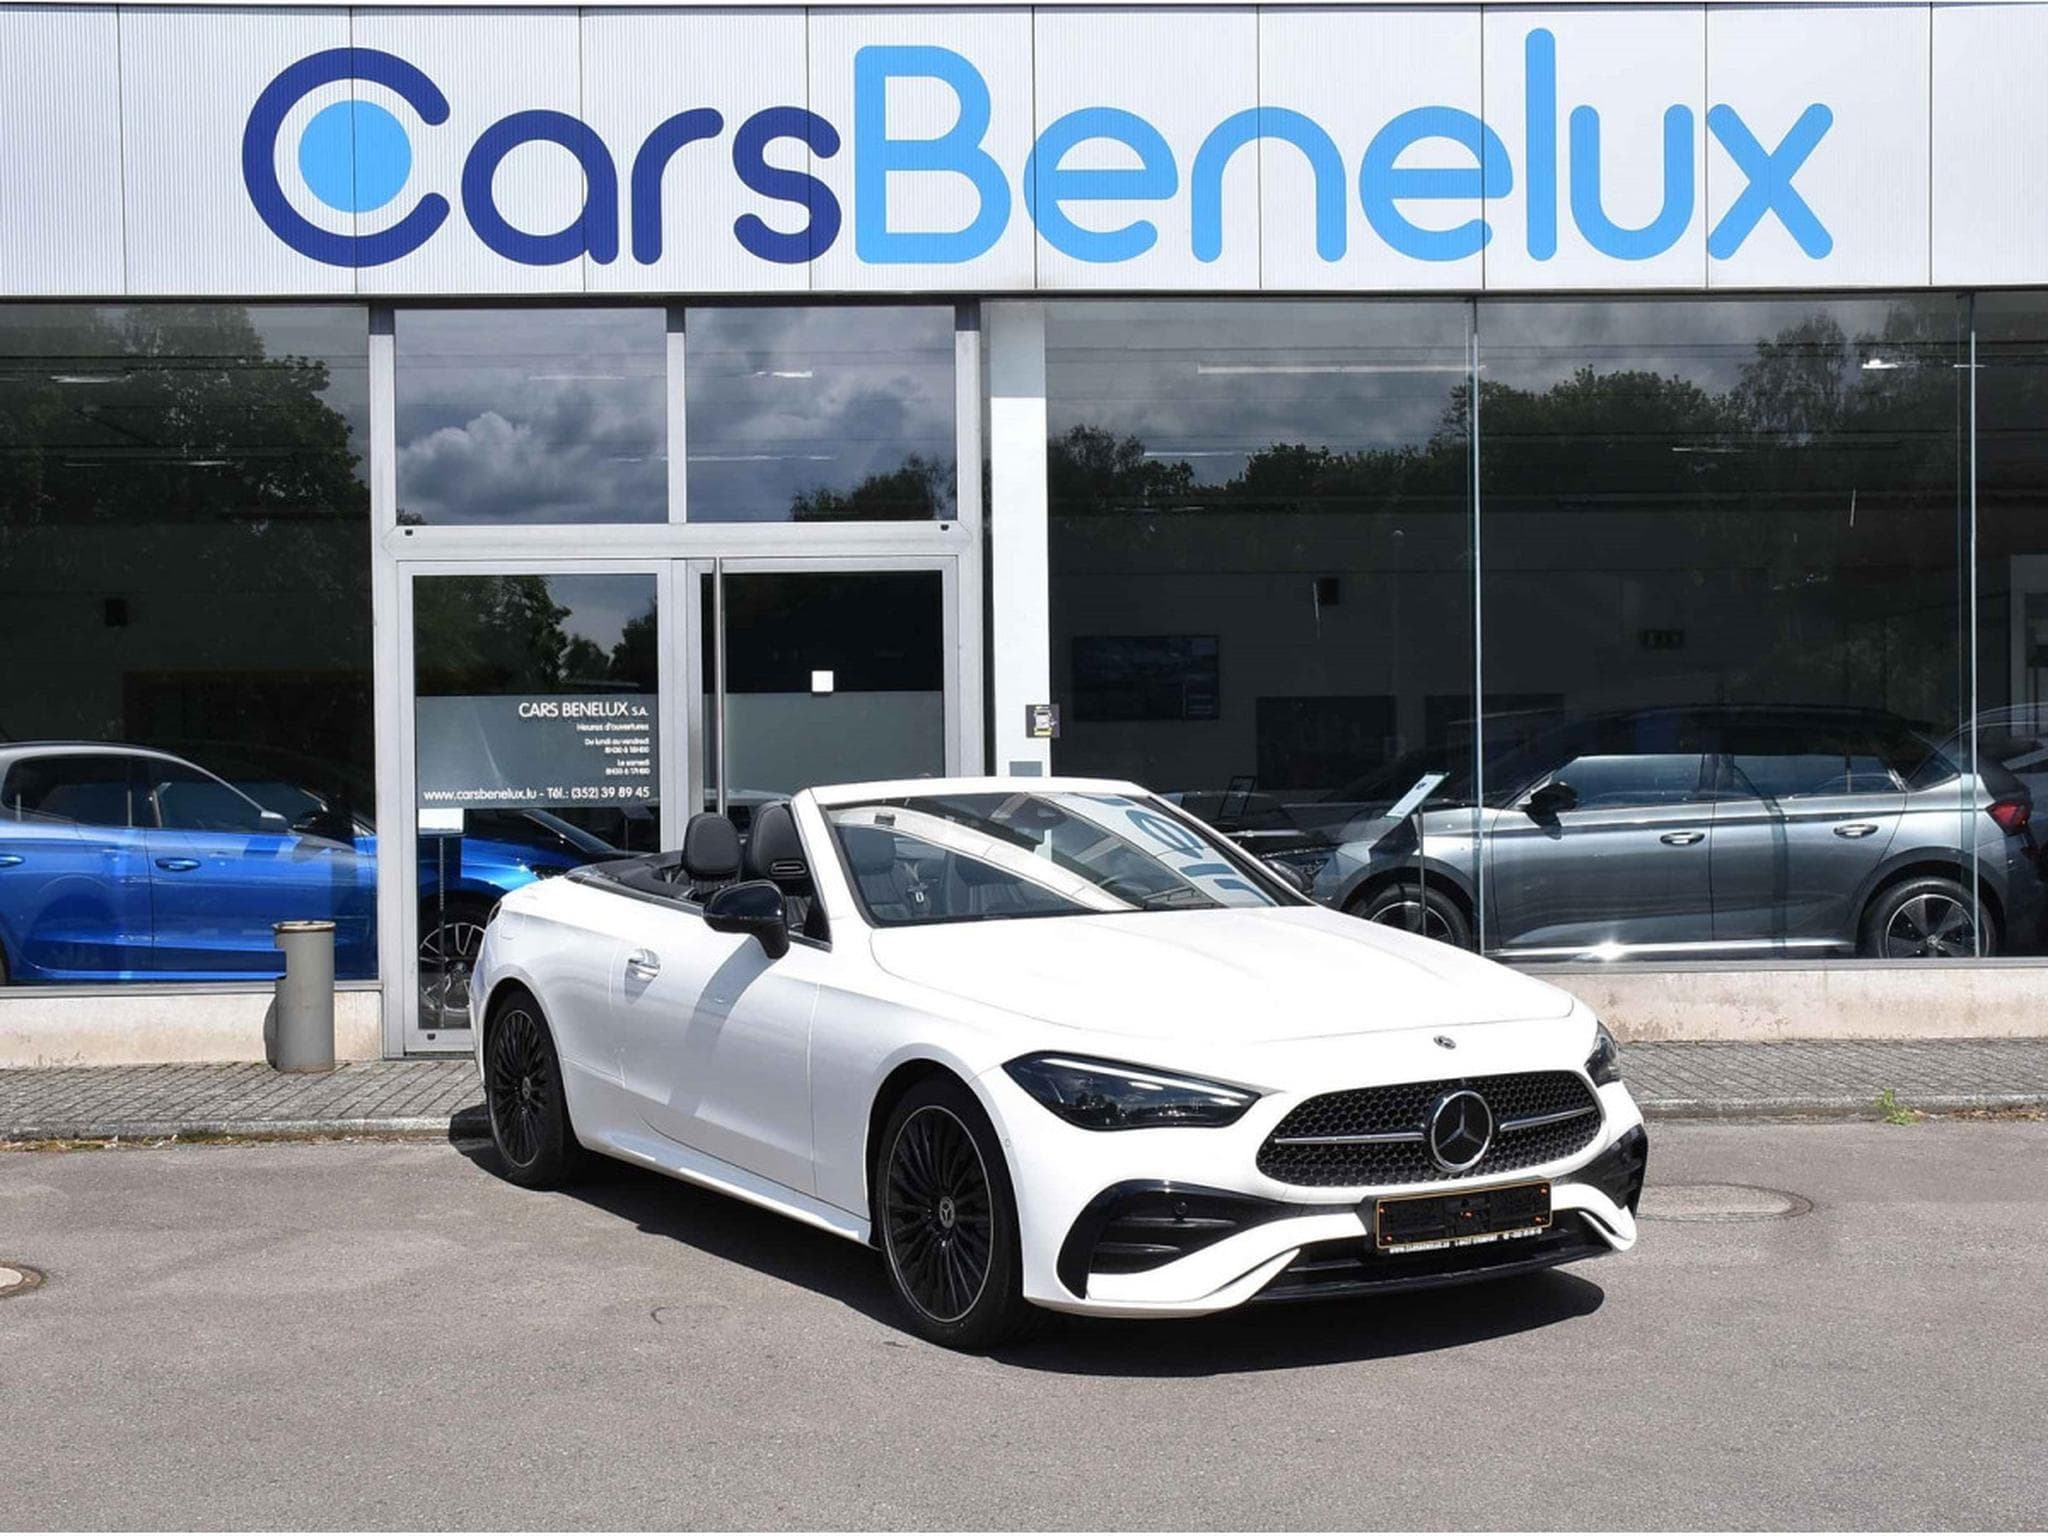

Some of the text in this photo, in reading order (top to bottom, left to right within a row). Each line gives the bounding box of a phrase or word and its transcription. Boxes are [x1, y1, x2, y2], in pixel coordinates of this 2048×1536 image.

[242, 28, 1833, 267] CarsBenelux
[519, 702, 649, 717] CARS BENELUX S.A.
[423, 787, 537, 801] www.carsbenelux.lu
[570, 786, 599, 799] (352)
[600, 786, 616, 798] 39
[618, 786, 633, 798] 89
[635, 786, 650, 798] 45
